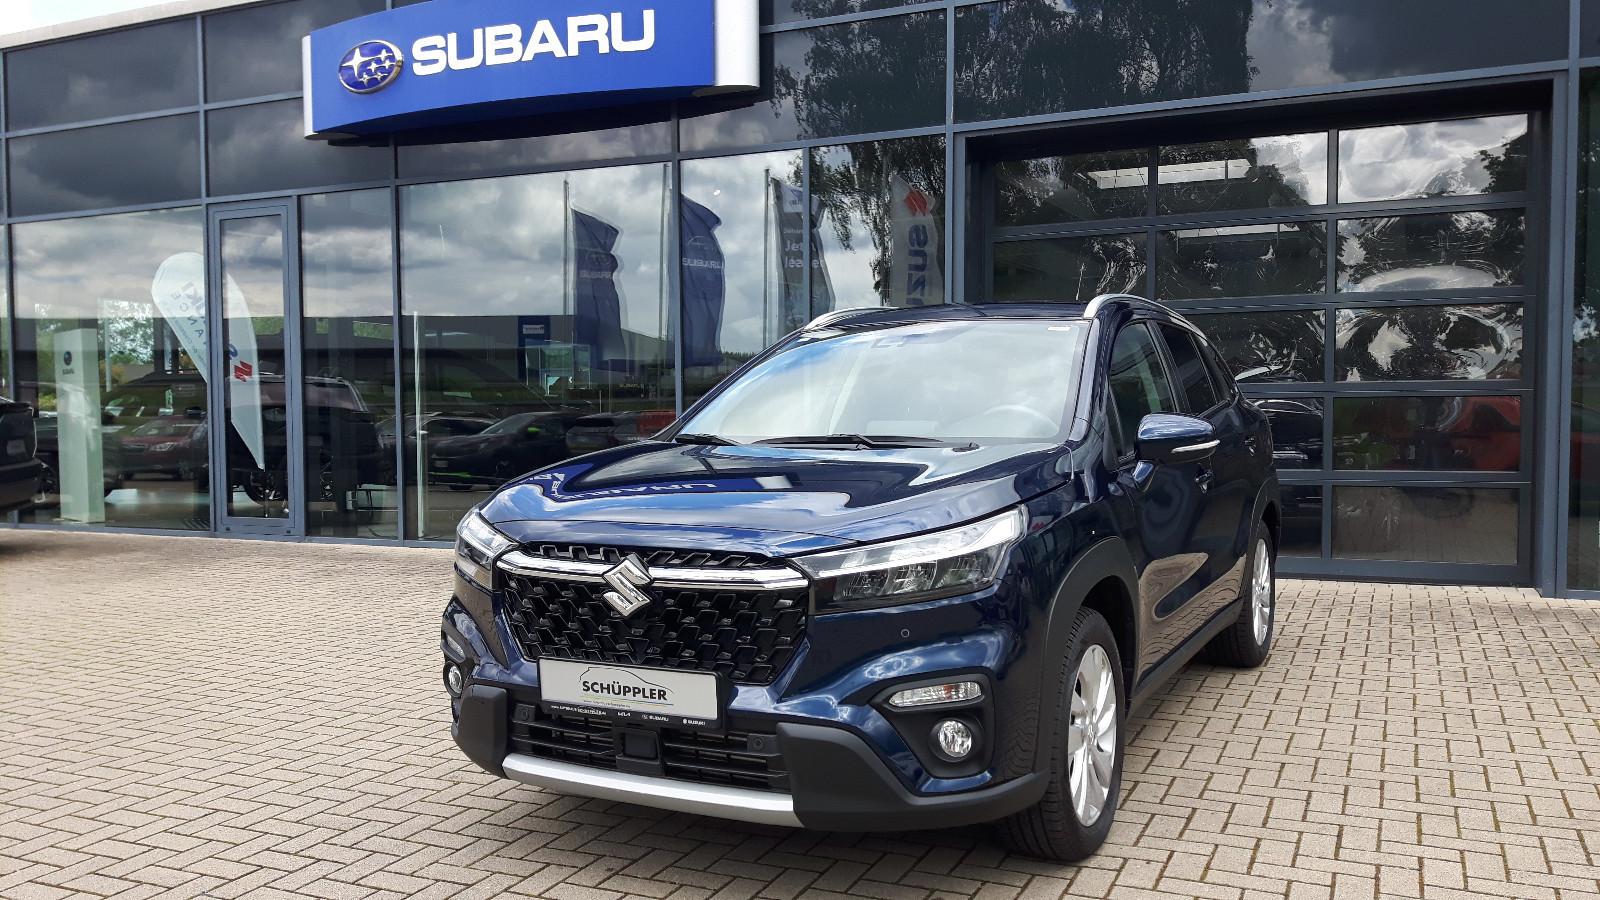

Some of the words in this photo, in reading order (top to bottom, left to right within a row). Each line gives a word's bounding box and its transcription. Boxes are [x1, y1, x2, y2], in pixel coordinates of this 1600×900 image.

[411, 9, 655, 77] SUBARU
[682, 257, 724, 269] SUBARU
[582, 680, 668, 701] SCHÜPPLER
